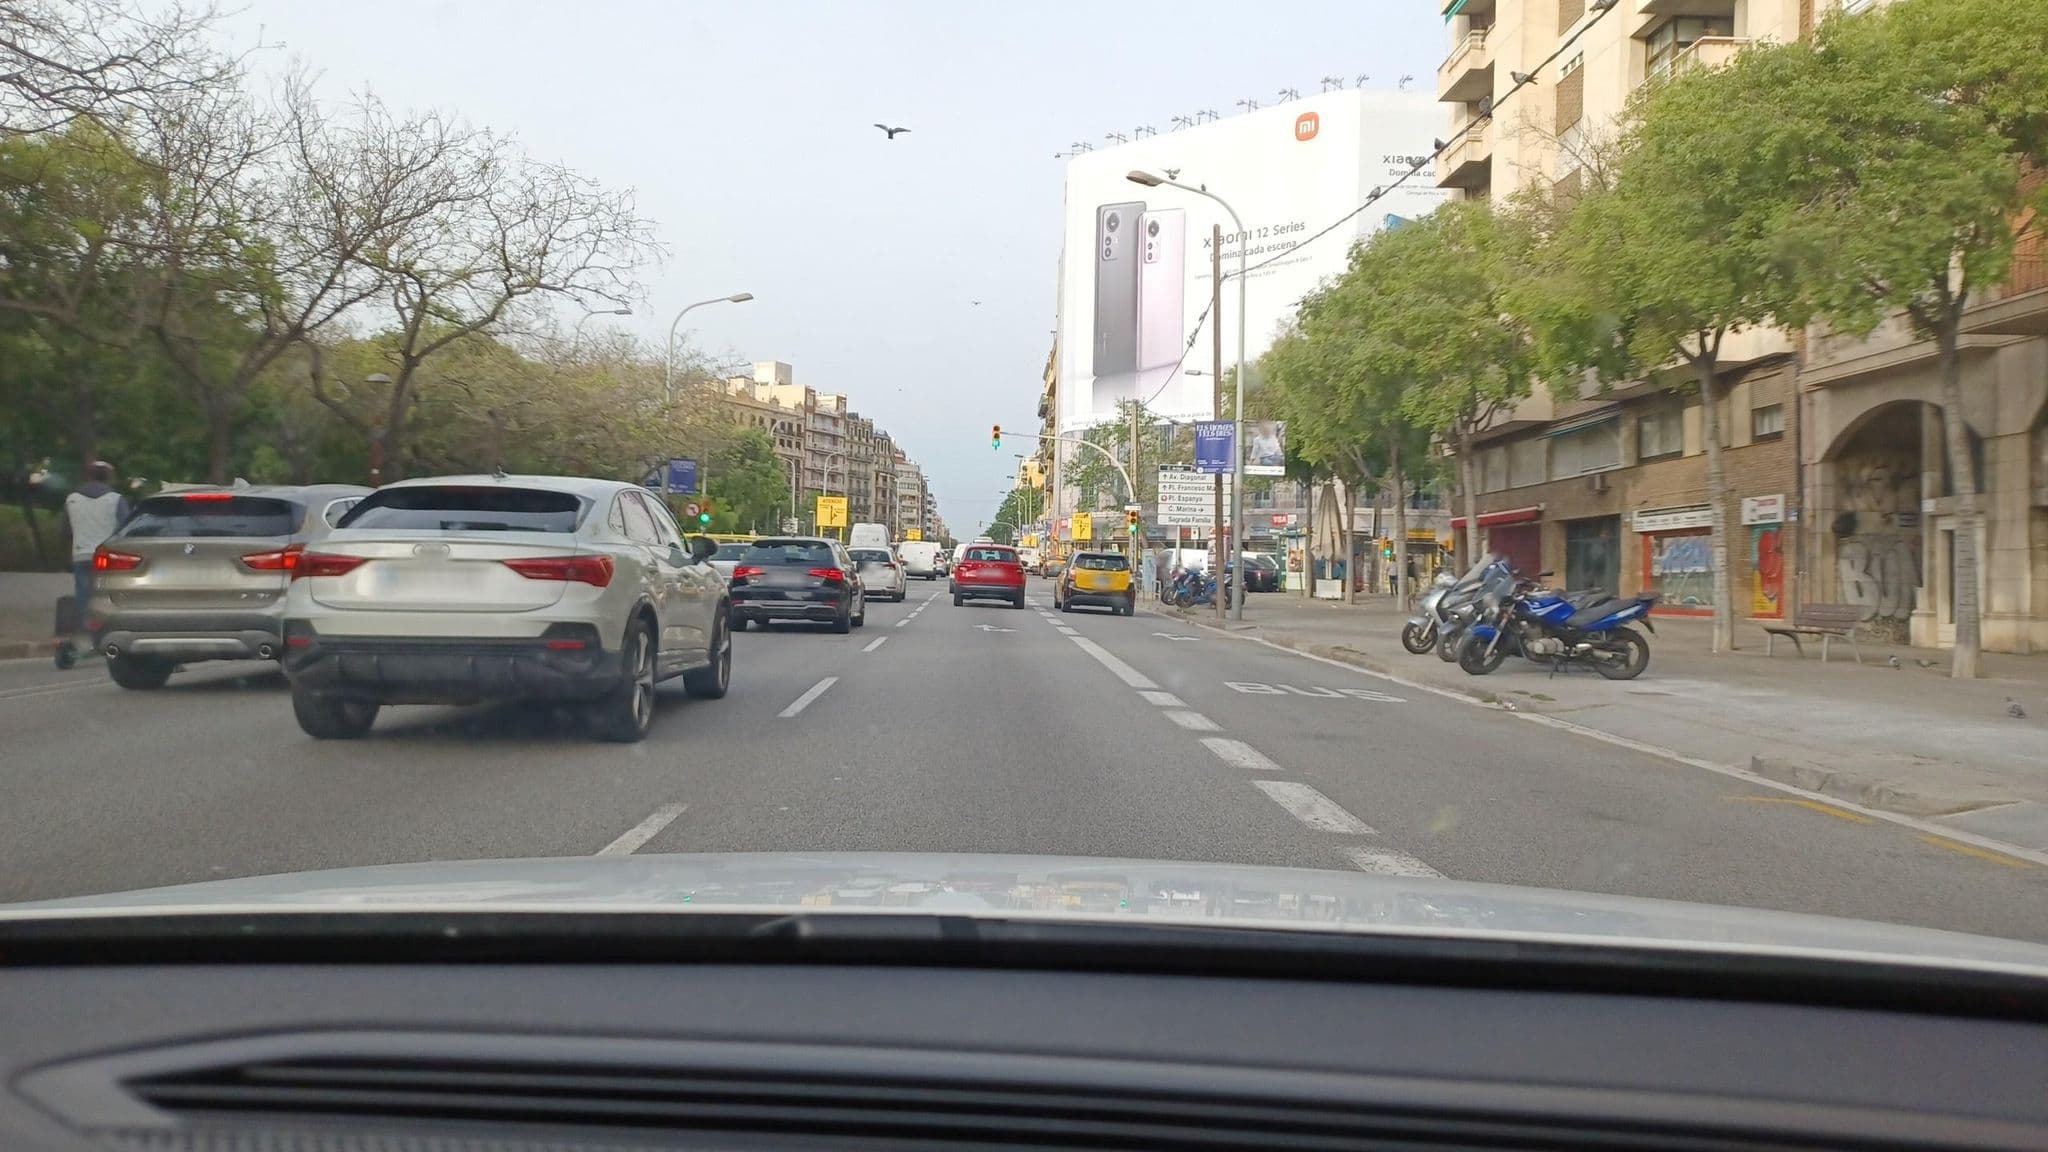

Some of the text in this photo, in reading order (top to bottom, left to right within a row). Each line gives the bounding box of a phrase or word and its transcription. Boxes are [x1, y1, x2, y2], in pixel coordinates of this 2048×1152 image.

[1203, 221, 1306, 248] xaomi 12 Series
[1210, 239, 1297, 262] Dmina cada escena
[1224, 681, 1407, 702] BUS
